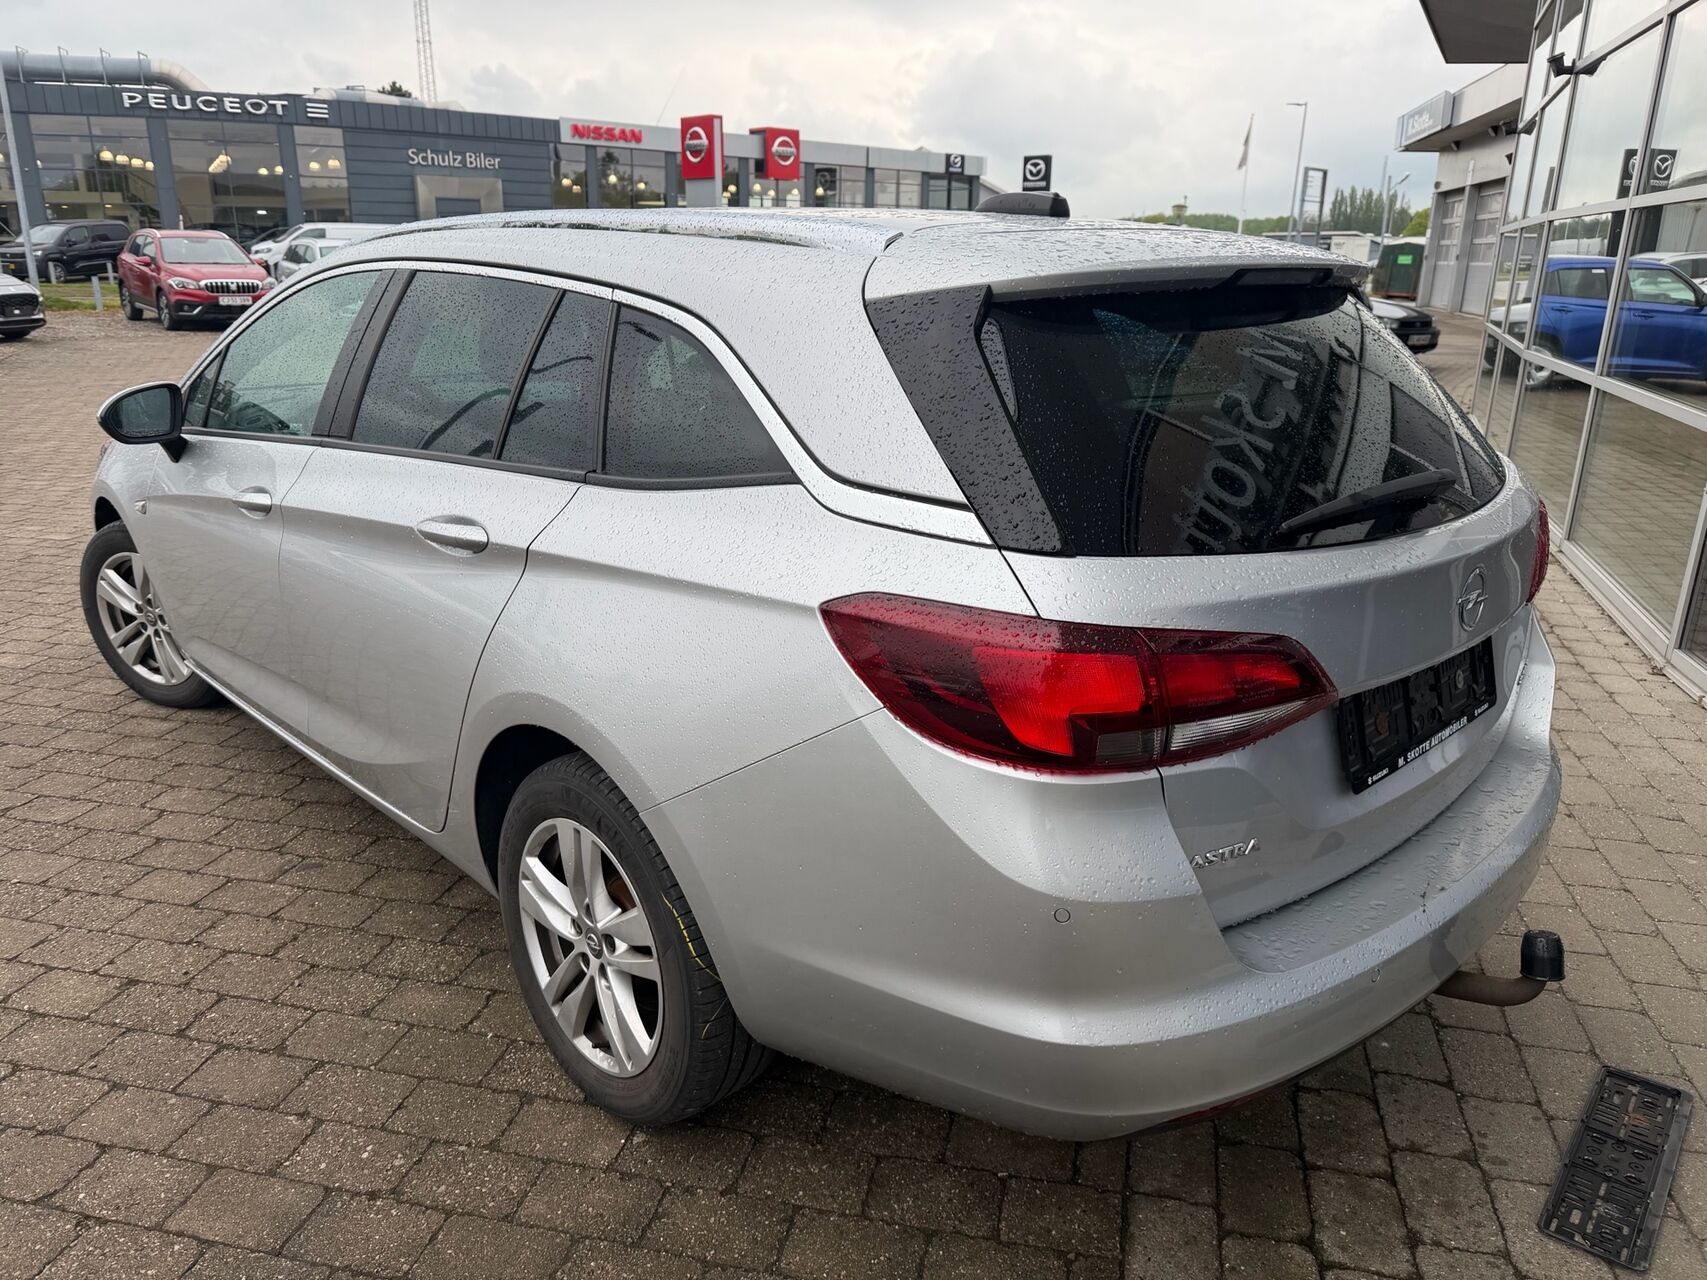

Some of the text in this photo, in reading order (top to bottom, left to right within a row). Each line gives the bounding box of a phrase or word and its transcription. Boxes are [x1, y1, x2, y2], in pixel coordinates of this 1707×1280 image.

[121, 92, 289, 115] PEUGEOT
[571, 123, 643, 144] NISSAN
[408, 148, 501, 169] Schulz Biler
[1398, 716, 1468, 768] M. SKOTTE AUTOMOBILER
[1191, 838, 1260, 868] ASTRA
